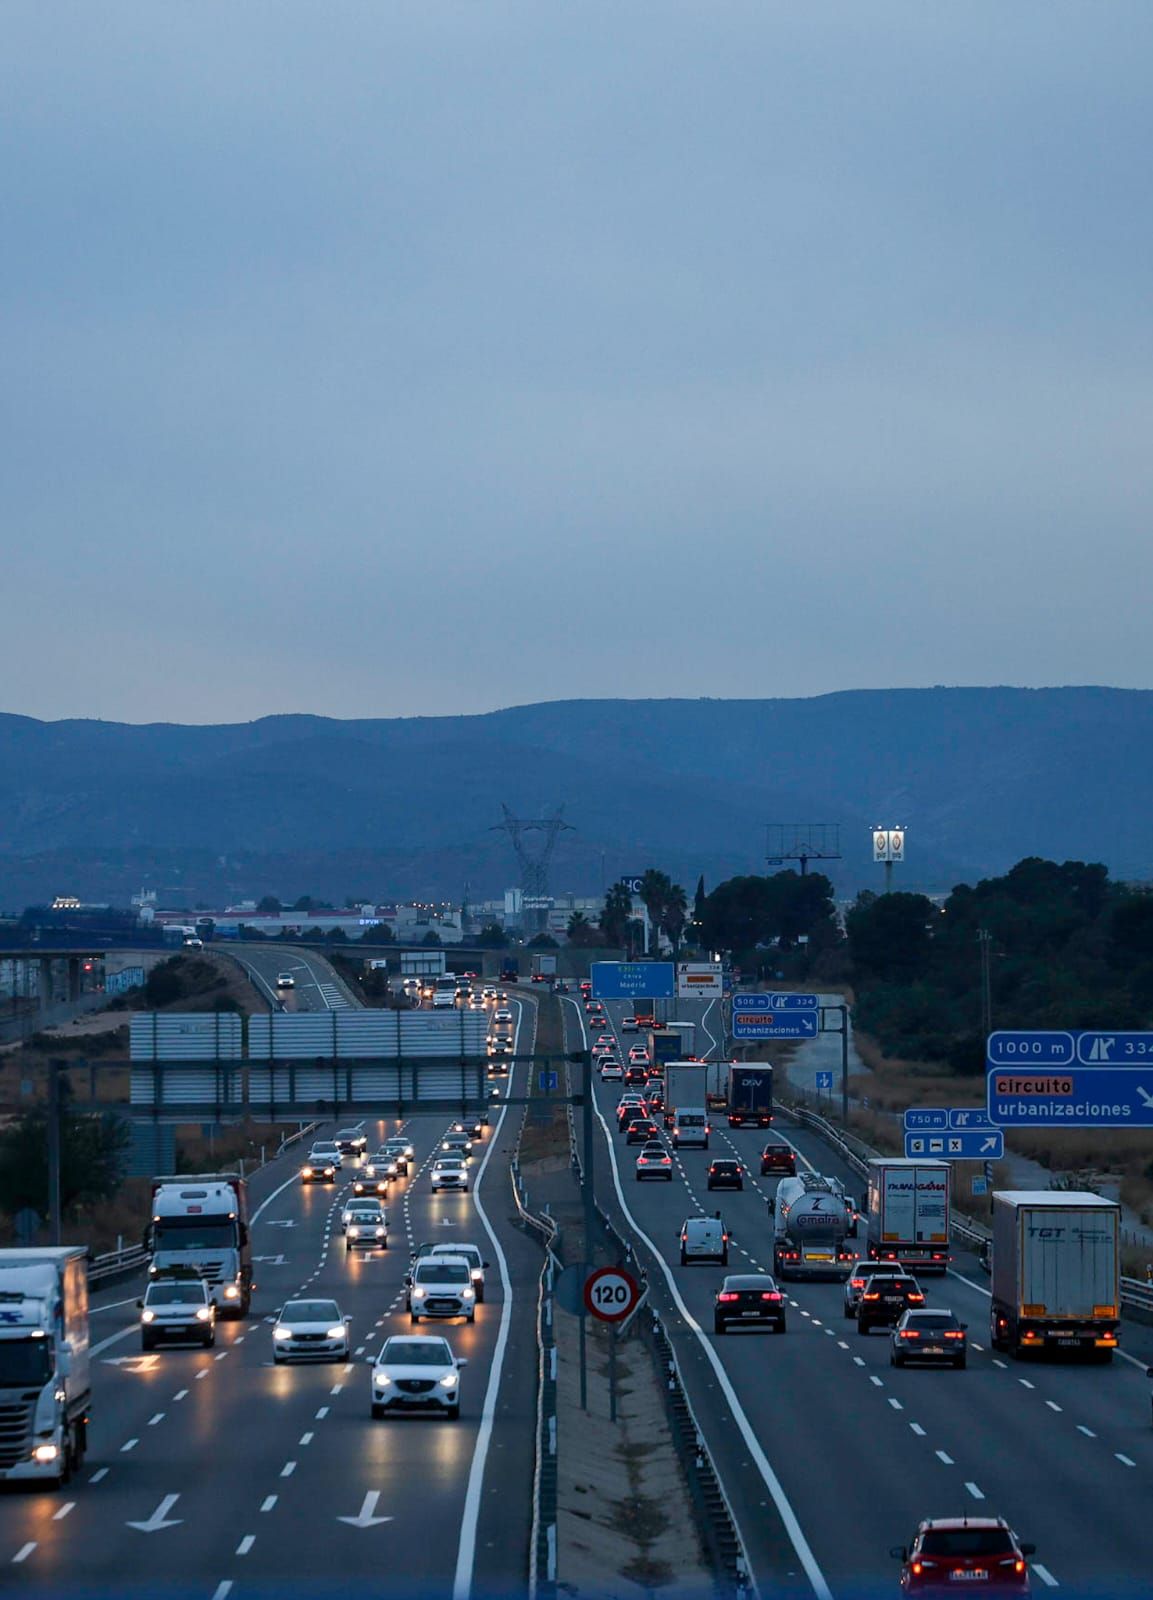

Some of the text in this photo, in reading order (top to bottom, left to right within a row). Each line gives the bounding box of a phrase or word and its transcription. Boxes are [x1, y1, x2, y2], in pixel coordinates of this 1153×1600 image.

[619, 981, 646, 989] Madrid
[737, 998, 754, 1006] 500
[796, 998, 814, 1006] 334
[737, 1015, 773, 1024] circuito
[737, 1026, 800, 1034] urbanizaciones
[998, 1042, 1064, 1054] 1000 m
[998, 1079, 1071, 1093] circuito
[998, 1101, 1131, 1116] urbanizaciones
[910, 1115, 931, 1123] 750
[1028, 1227, 1065, 1238] TGT
[595, 1286, 627, 1303] 120
